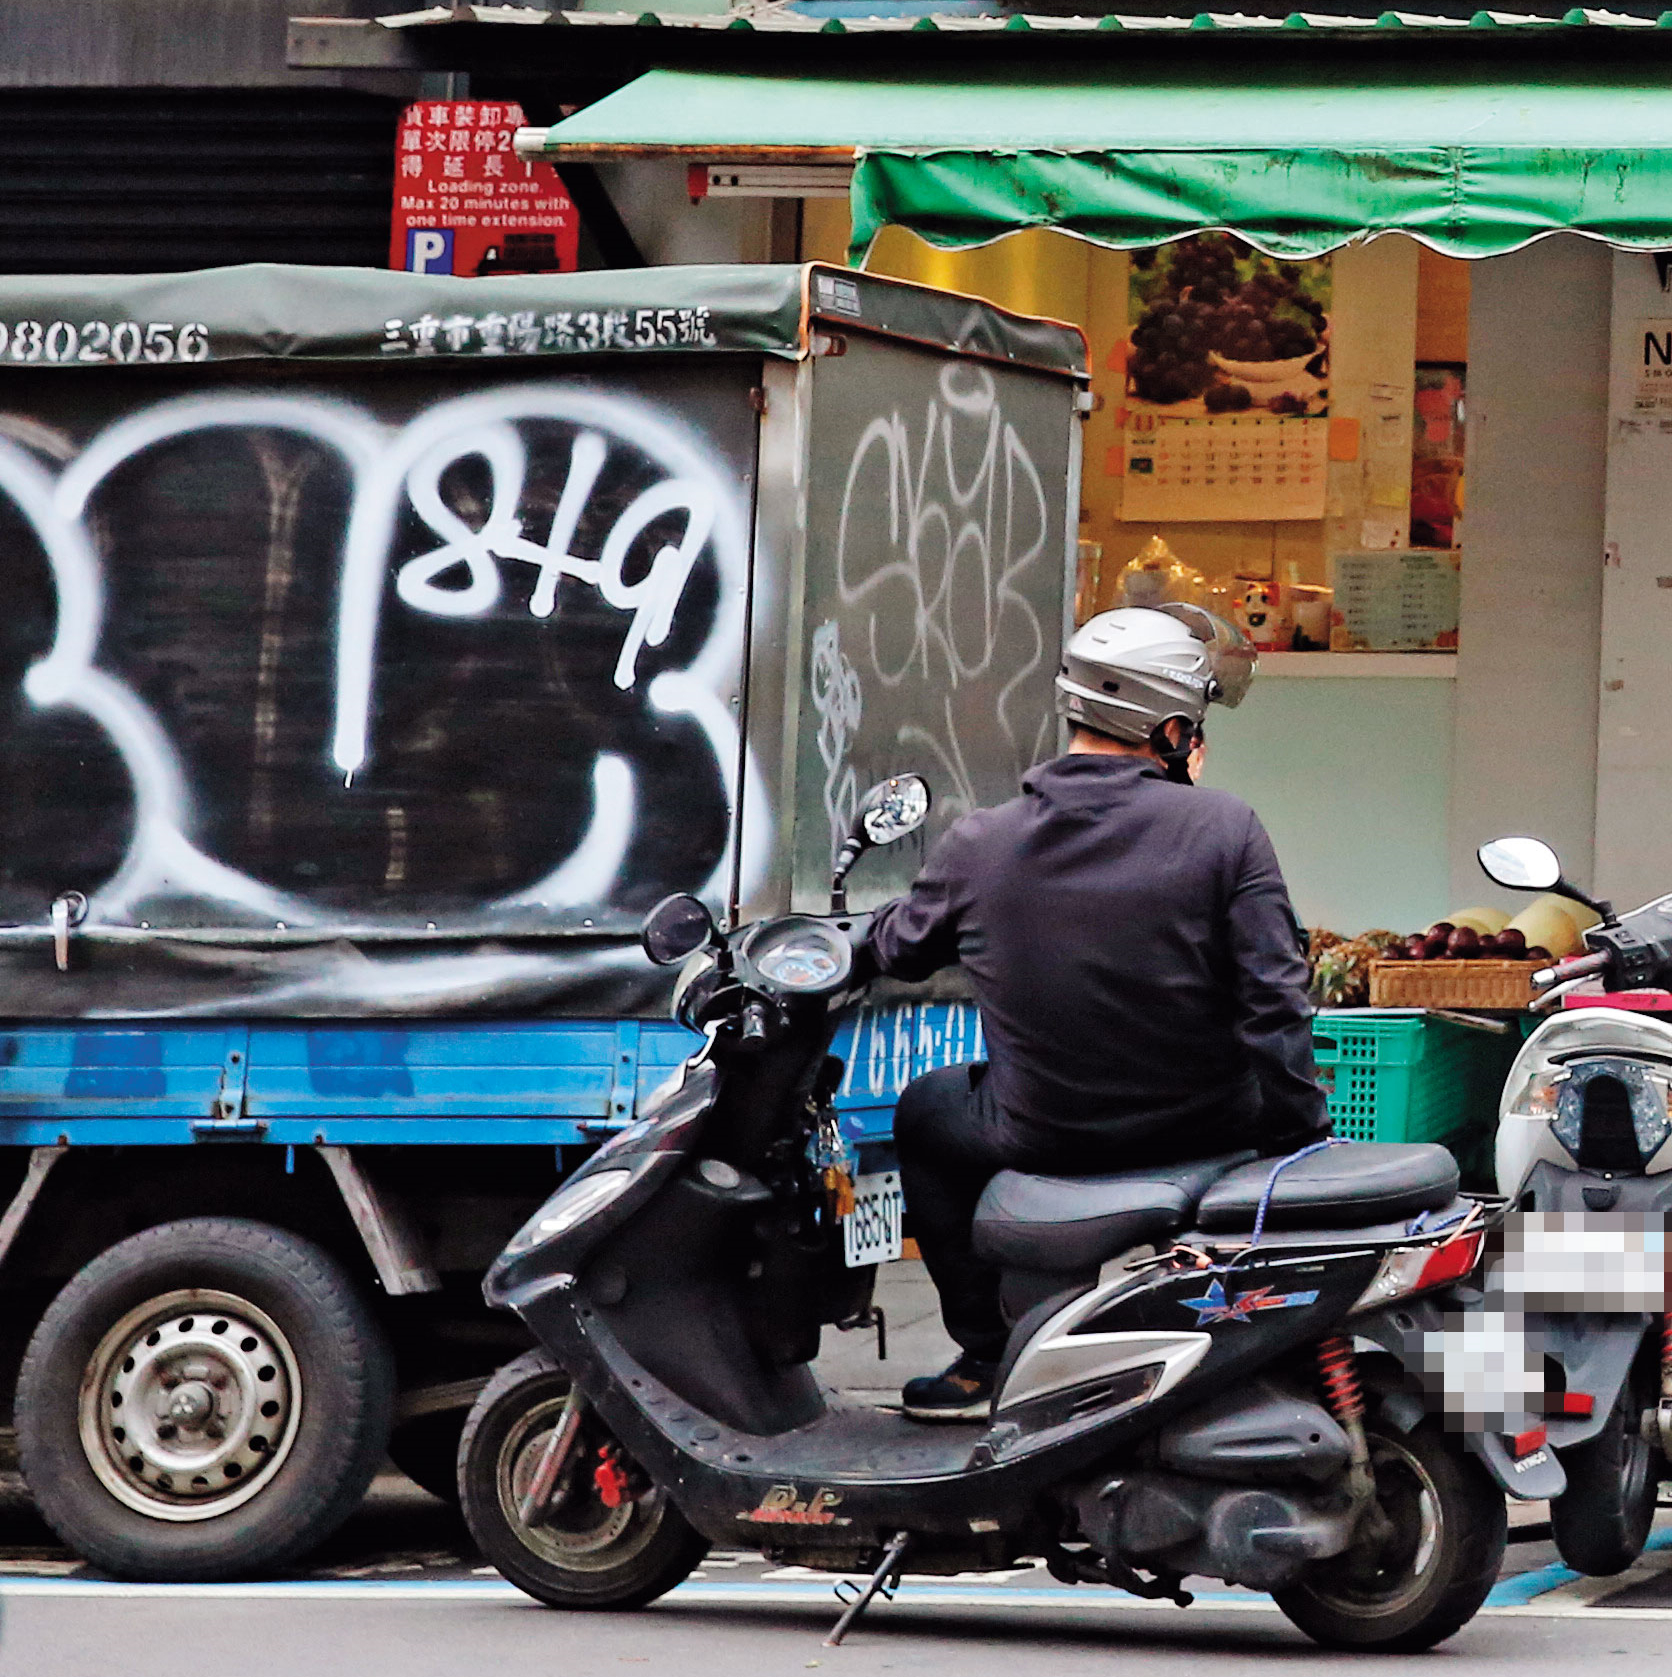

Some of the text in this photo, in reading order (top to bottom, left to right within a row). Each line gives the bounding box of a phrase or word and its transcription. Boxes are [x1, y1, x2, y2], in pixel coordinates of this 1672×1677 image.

[428, 179, 494, 197] Loading
[401, 196, 571, 211] Max 20 minutes with
[406, 214, 437, 227] one
[441, 213, 477, 227] time
[414, 231, 446, 274] P
[0, 320, 209, 362] 802056
